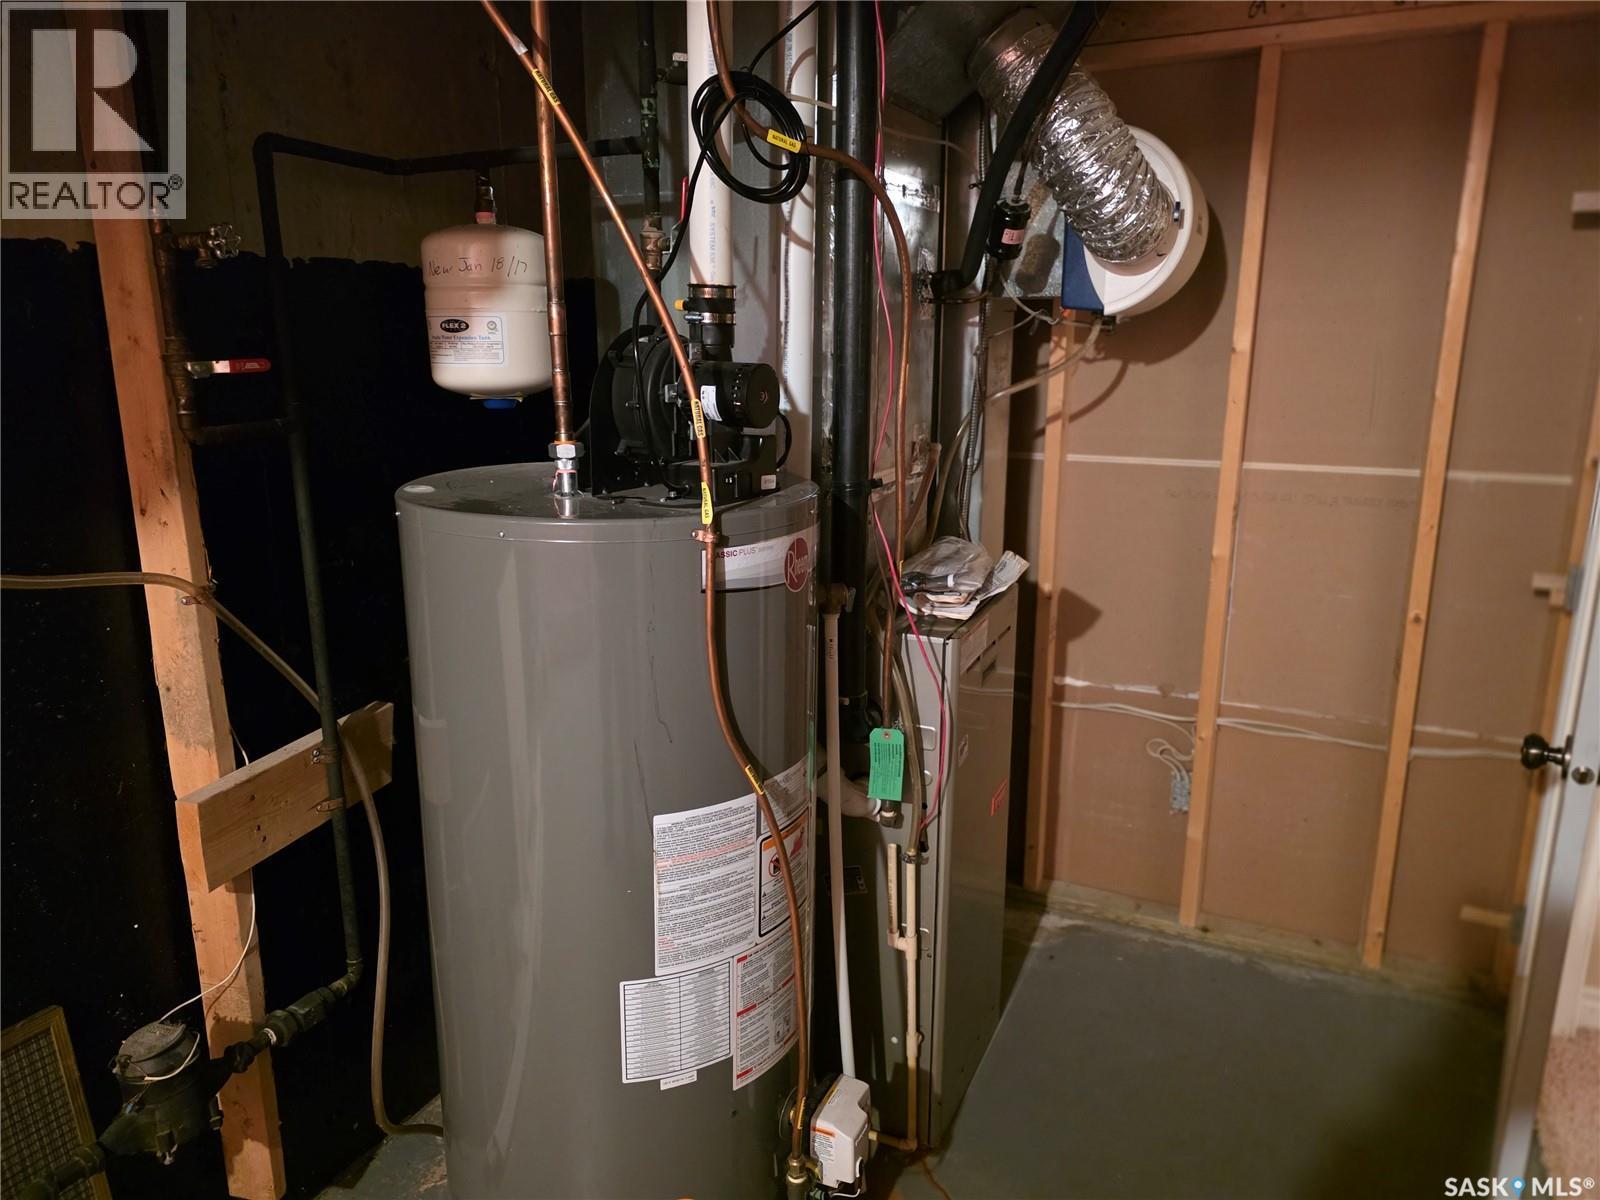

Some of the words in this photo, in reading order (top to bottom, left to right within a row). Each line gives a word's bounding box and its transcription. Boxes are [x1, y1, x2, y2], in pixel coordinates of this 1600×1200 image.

[772, 134, 788, 144] NATURAL
[428, 260, 453, 276] New
[458, 257, 482, 272] Jan
[702, 487, 710, 511] NATURAL
[738, 547, 756, 556] PLUS
